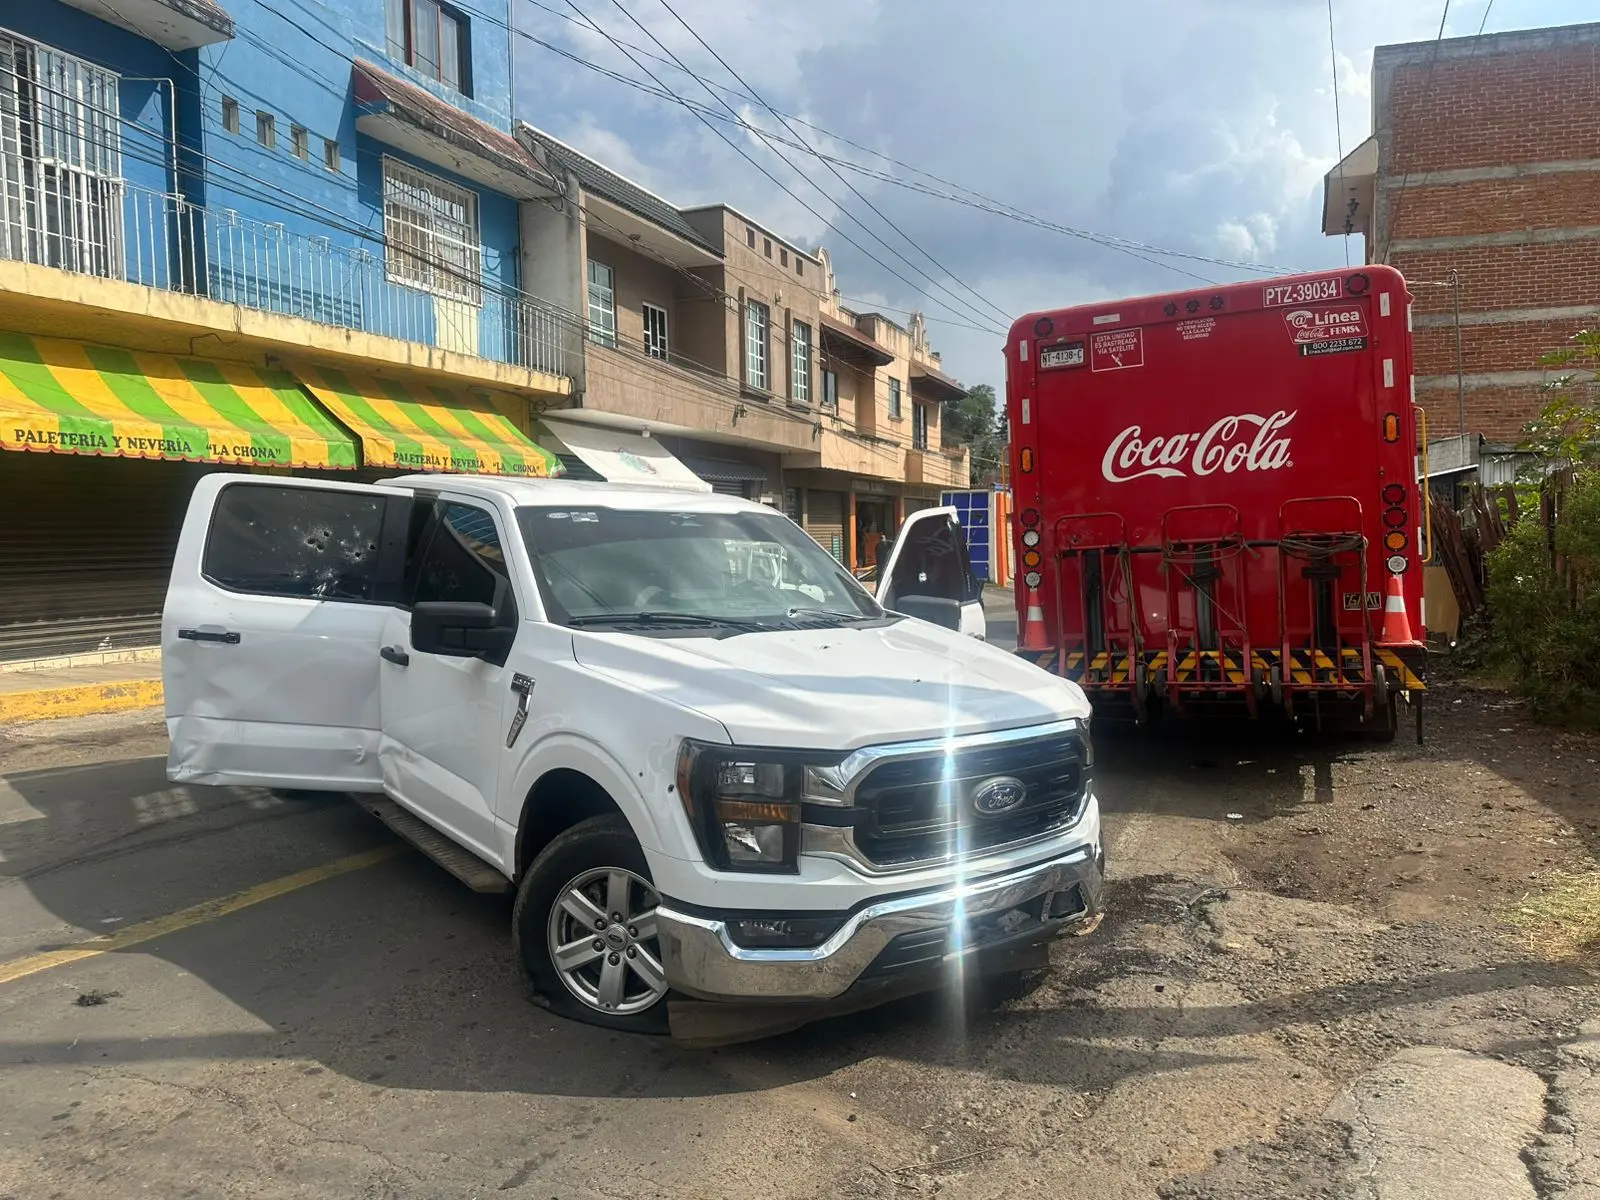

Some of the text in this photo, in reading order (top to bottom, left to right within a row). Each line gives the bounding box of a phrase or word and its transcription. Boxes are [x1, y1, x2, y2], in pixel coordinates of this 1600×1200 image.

[1266, 280, 1337, 305] PTZ-39034
[1314, 310, 1360, 325] Línea
[1096, 331, 1136, 343] ESTA UNIDAD
[1330, 325, 1361, 336] FEMSA
[1102, 337, 1138, 347] RASTREADA
[1312, 342, 1328, 350] 800
[1042, 350, 1082, 363] NT-4138-C
[14, 428, 108, 448] PALETERÍA
[113, 436, 122, 448] Y
[128, 437, 192, 453] NEVERÍA
[1101, 409, 1298, 484] Coca-Cola
[393, 452, 441, 466] PALETERÍA
[442, 457, 449, 466] Y
[450, 458, 485, 469] NEVERÍA
[988, 788, 1016, 808] Ford
